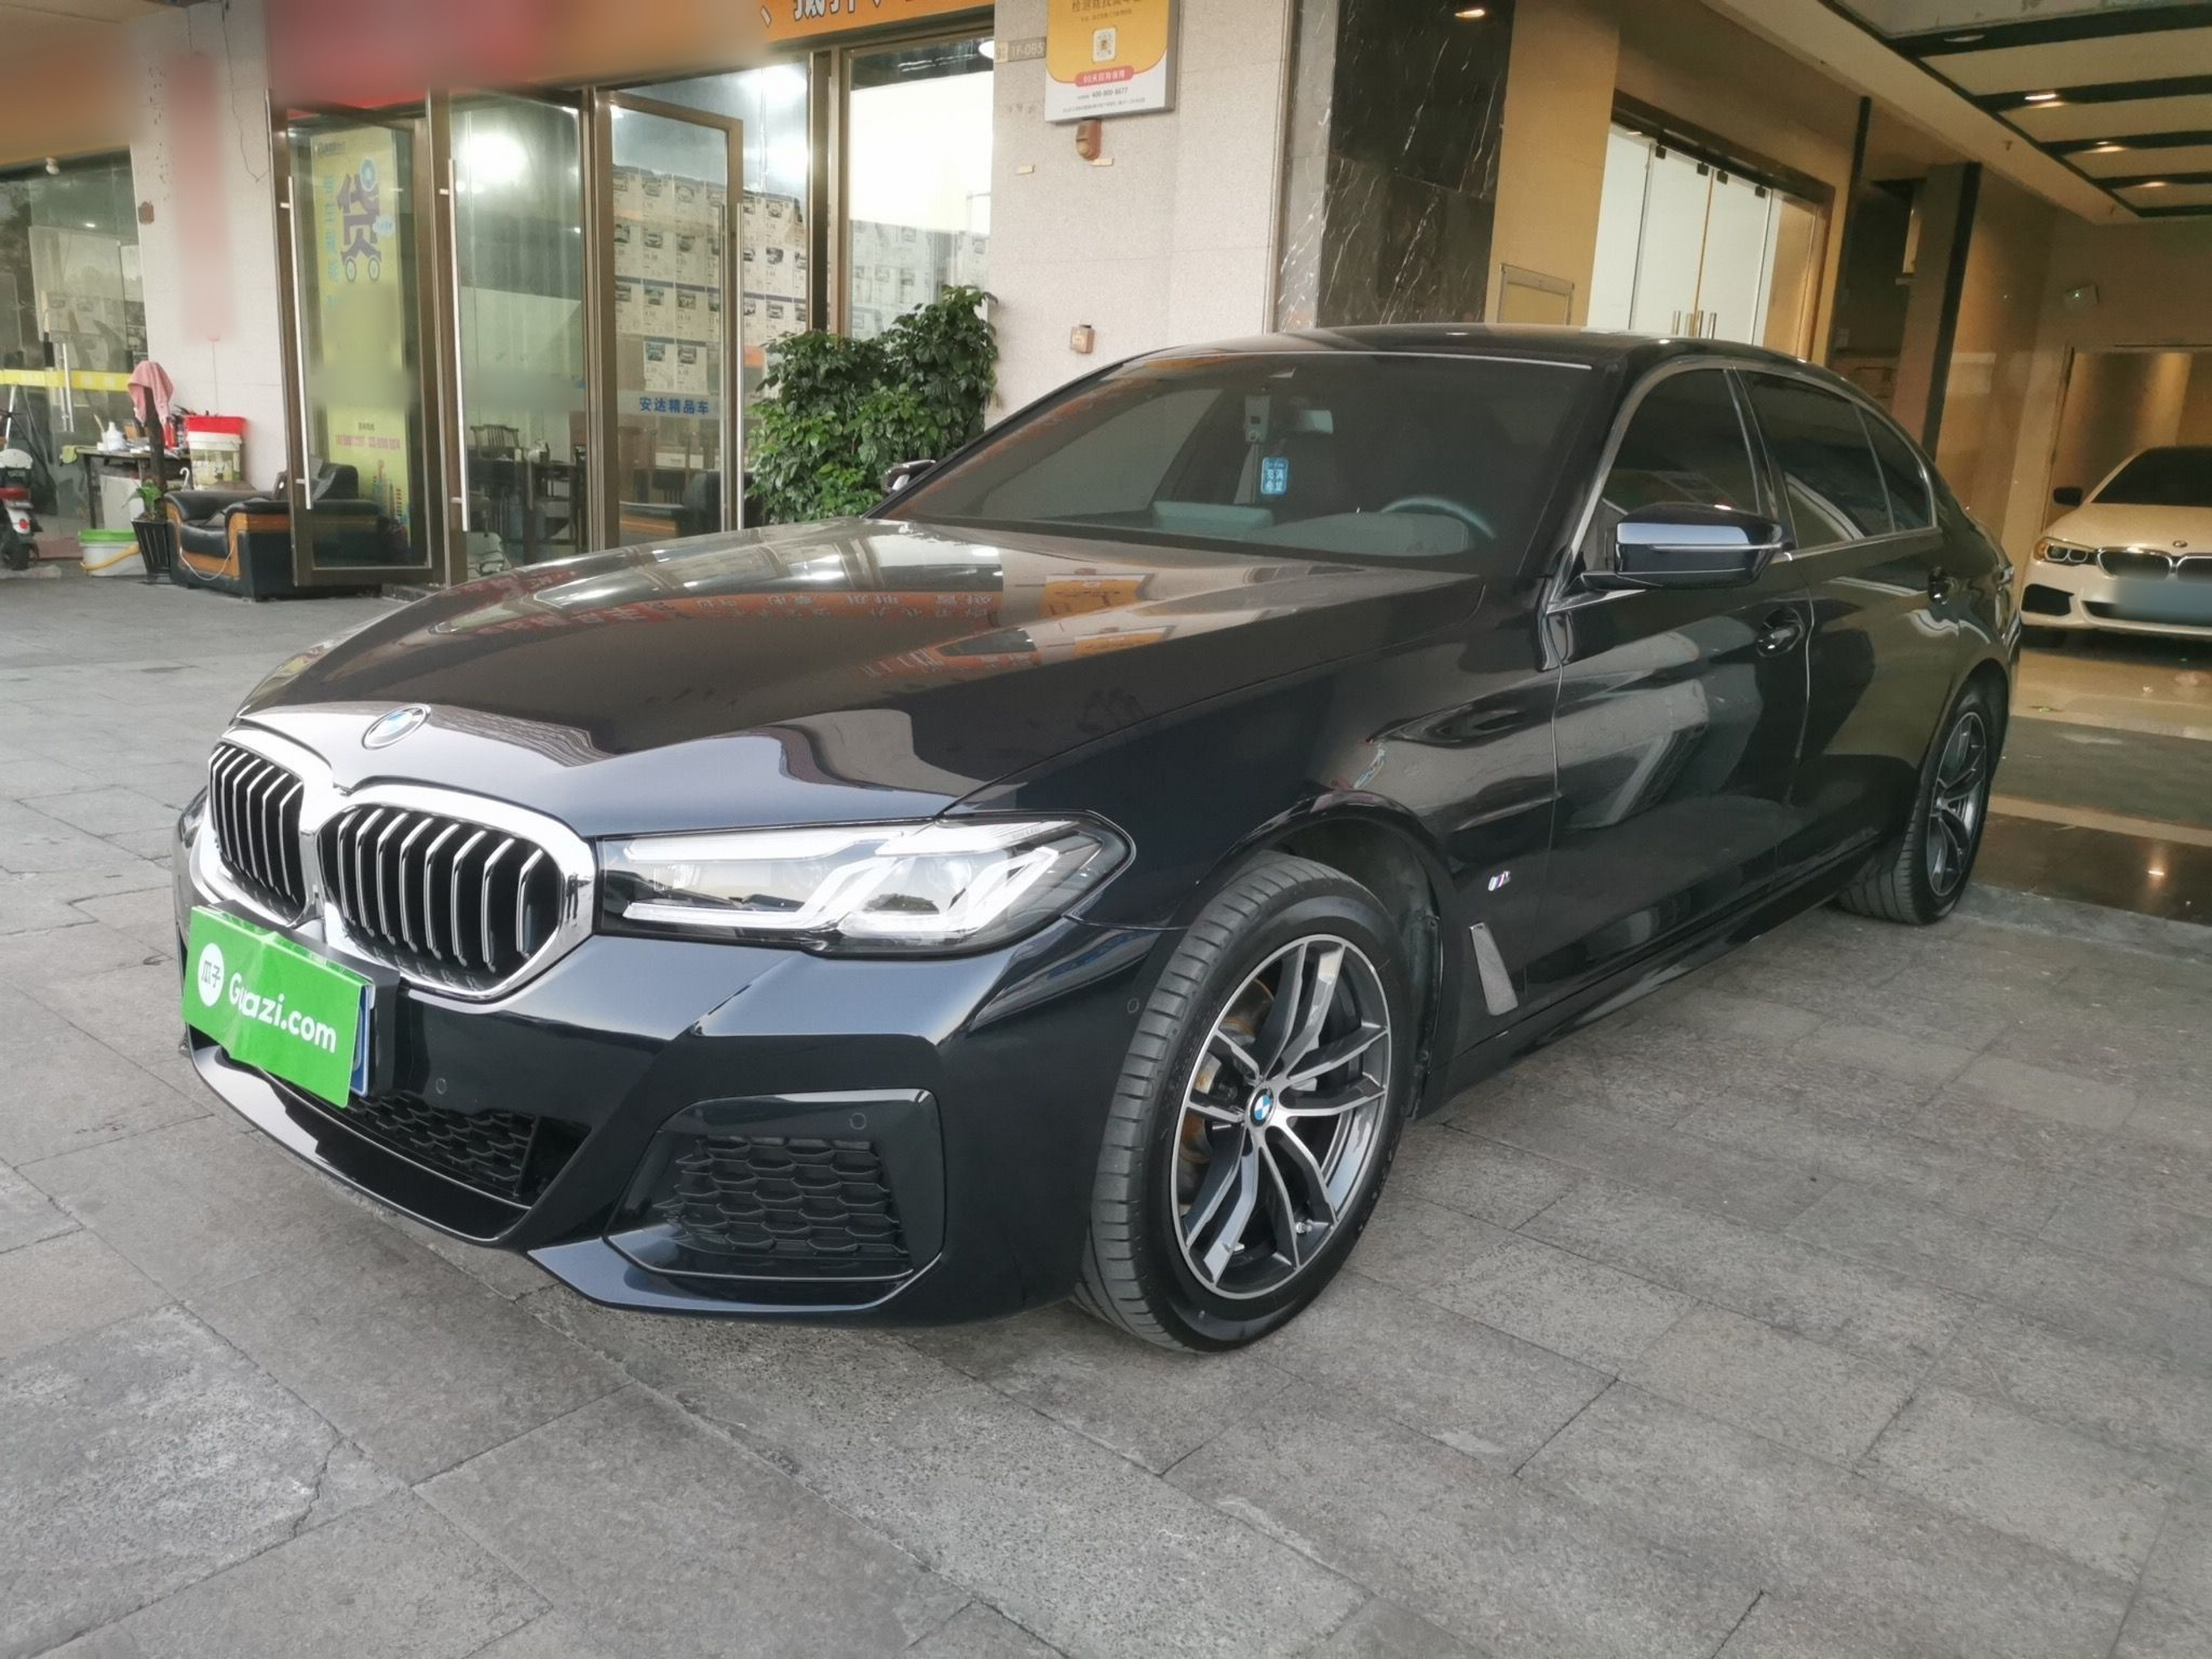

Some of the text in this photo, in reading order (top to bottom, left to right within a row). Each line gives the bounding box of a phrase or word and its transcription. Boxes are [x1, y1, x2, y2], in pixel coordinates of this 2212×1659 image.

[639, 396, 709, 415] 安达精品车
[201, 960, 221, 989] 瓜子
[229, 972, 337, 1054] Guazi.com
